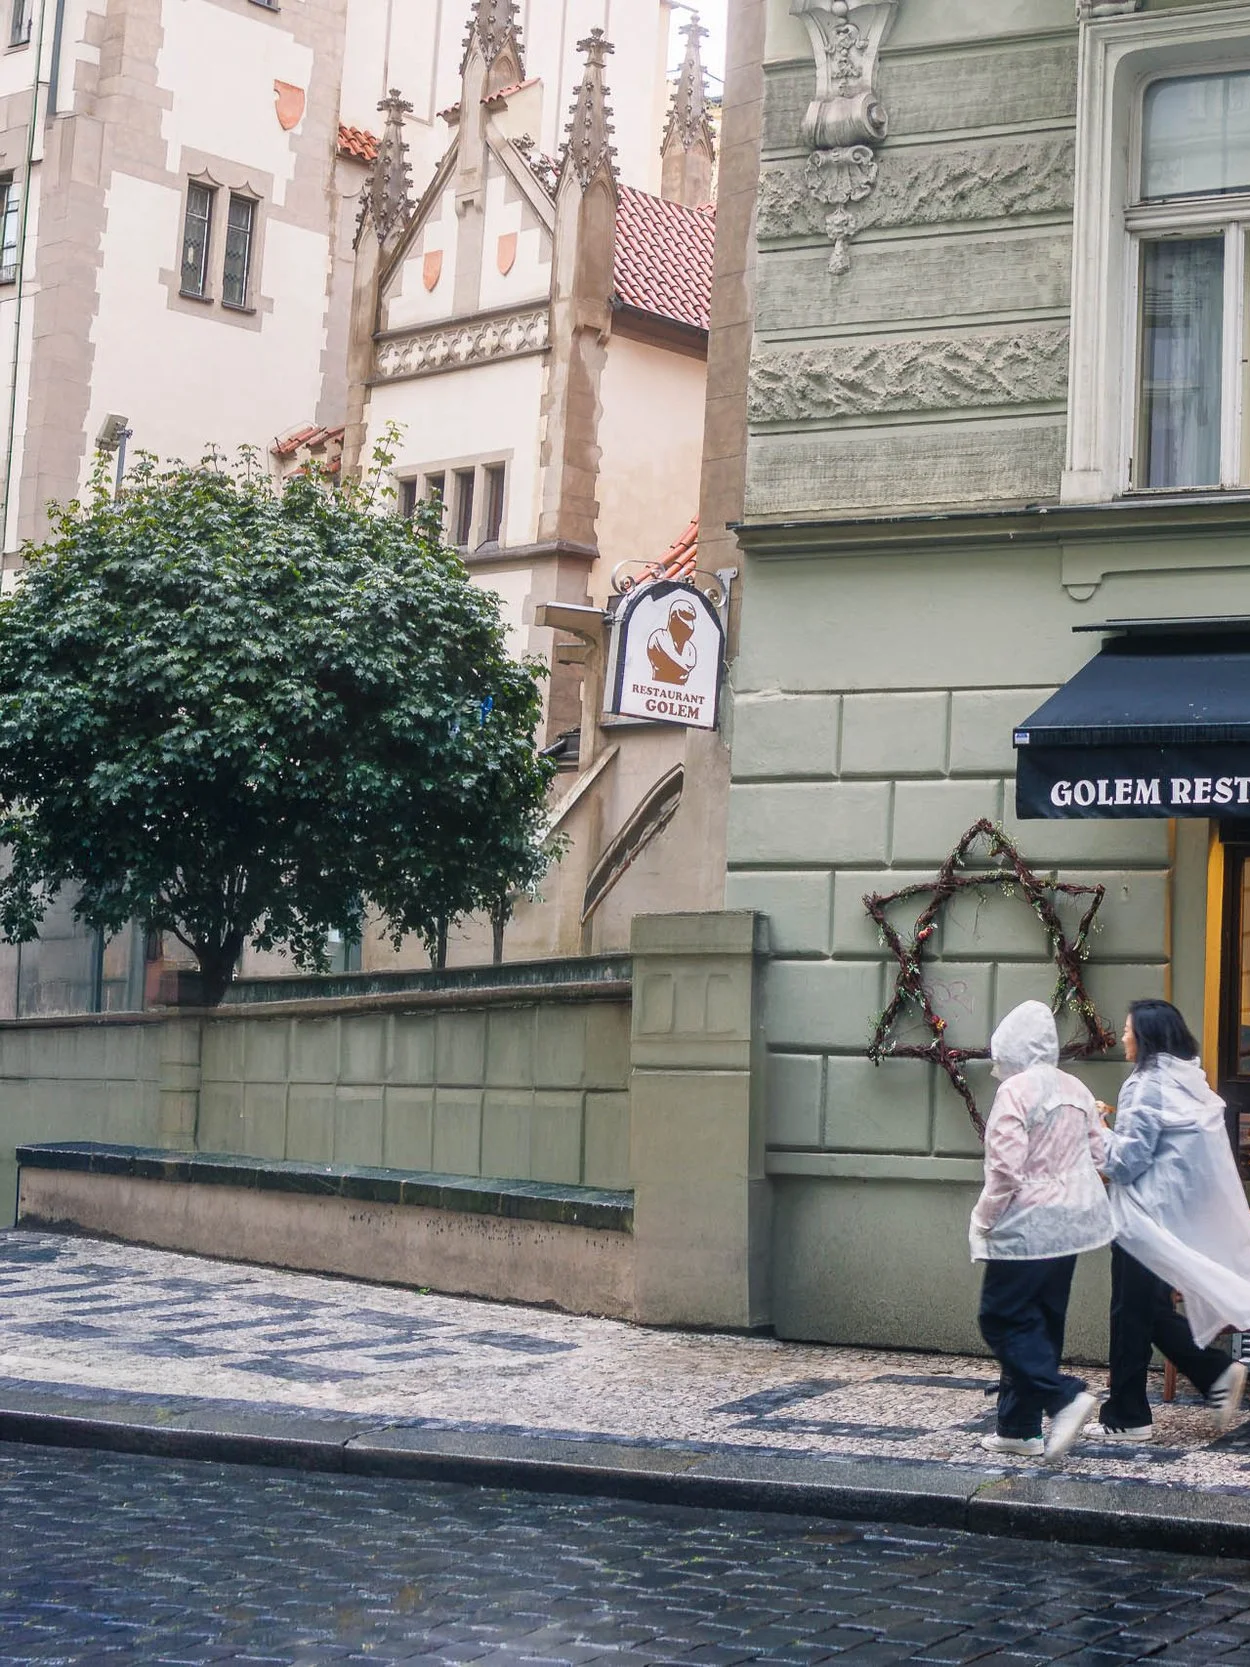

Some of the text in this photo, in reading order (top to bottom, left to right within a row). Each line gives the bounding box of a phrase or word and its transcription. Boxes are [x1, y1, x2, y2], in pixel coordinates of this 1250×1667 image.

[632, 684, 705, 705] RESTAURANT
[645, 699, 700, 720] GOLEM
[1050, 778, 1162, 806] GOLEM
